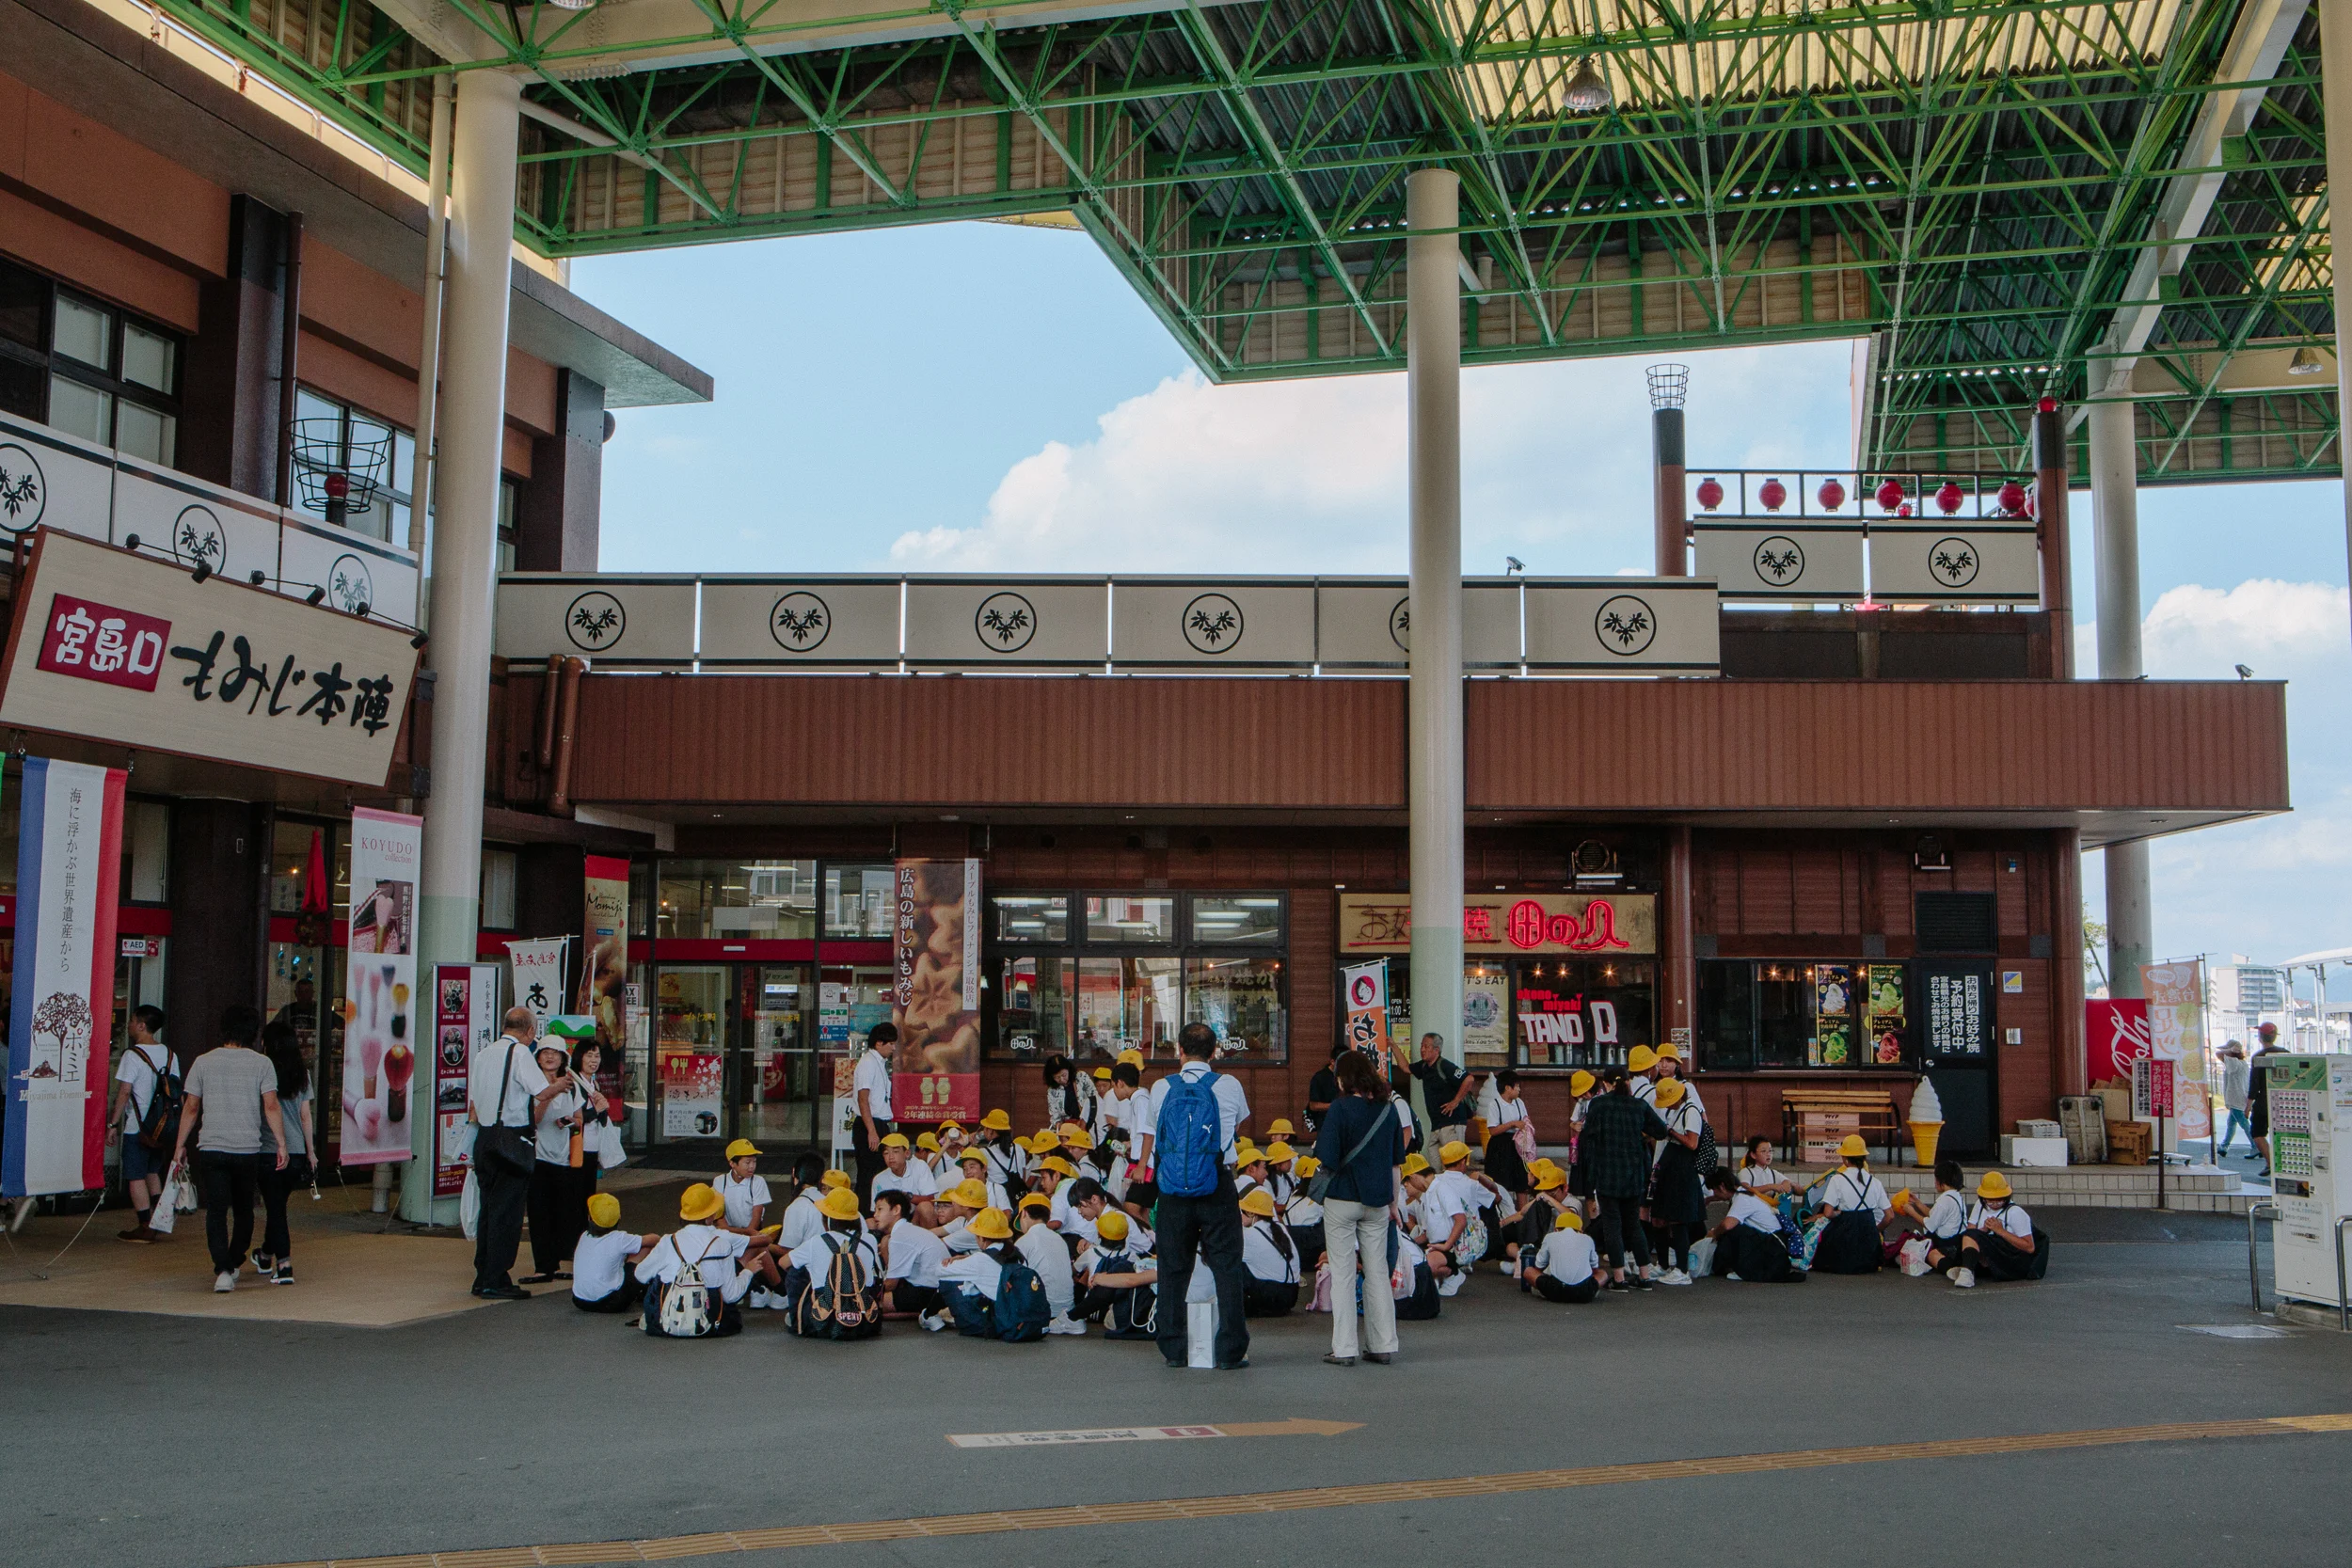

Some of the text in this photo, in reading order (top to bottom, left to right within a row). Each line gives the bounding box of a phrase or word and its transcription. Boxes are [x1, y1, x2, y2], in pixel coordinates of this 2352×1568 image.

[56, 606, 163, 675] 宮島口
[170, 630, 394, 737] もみじ本陣
[60, 787, 83, 973] 海に浮かぶ世界遺産から
[361, 837, 413, 855] KOYUDO
[384, 853, 412, 863] collection
[130, 941, 144, 949] AED
[898, 867, 915, 1007] 広島の新しいもみじ
[965, 863, 976, 1004] メープルもみじフィナンシェ取扱店
[1509, 899, 1630, 950] 田の久
[627, 997, 637, 1006] EE
[1464, 976, 1506, 985] T'S EAT
[1931, 976, 1941, 1048] 合わせてお焼き致します
[1940, 976, 1951, 1053] 宮島観光のお帰りの時間に
[1950, 980, 1964, 1050] 予約受付中
[1965, 975, 1980, 1053] お持ち帰りお好み焼
[1518, 1001, 1618, 1043] TANO Q
